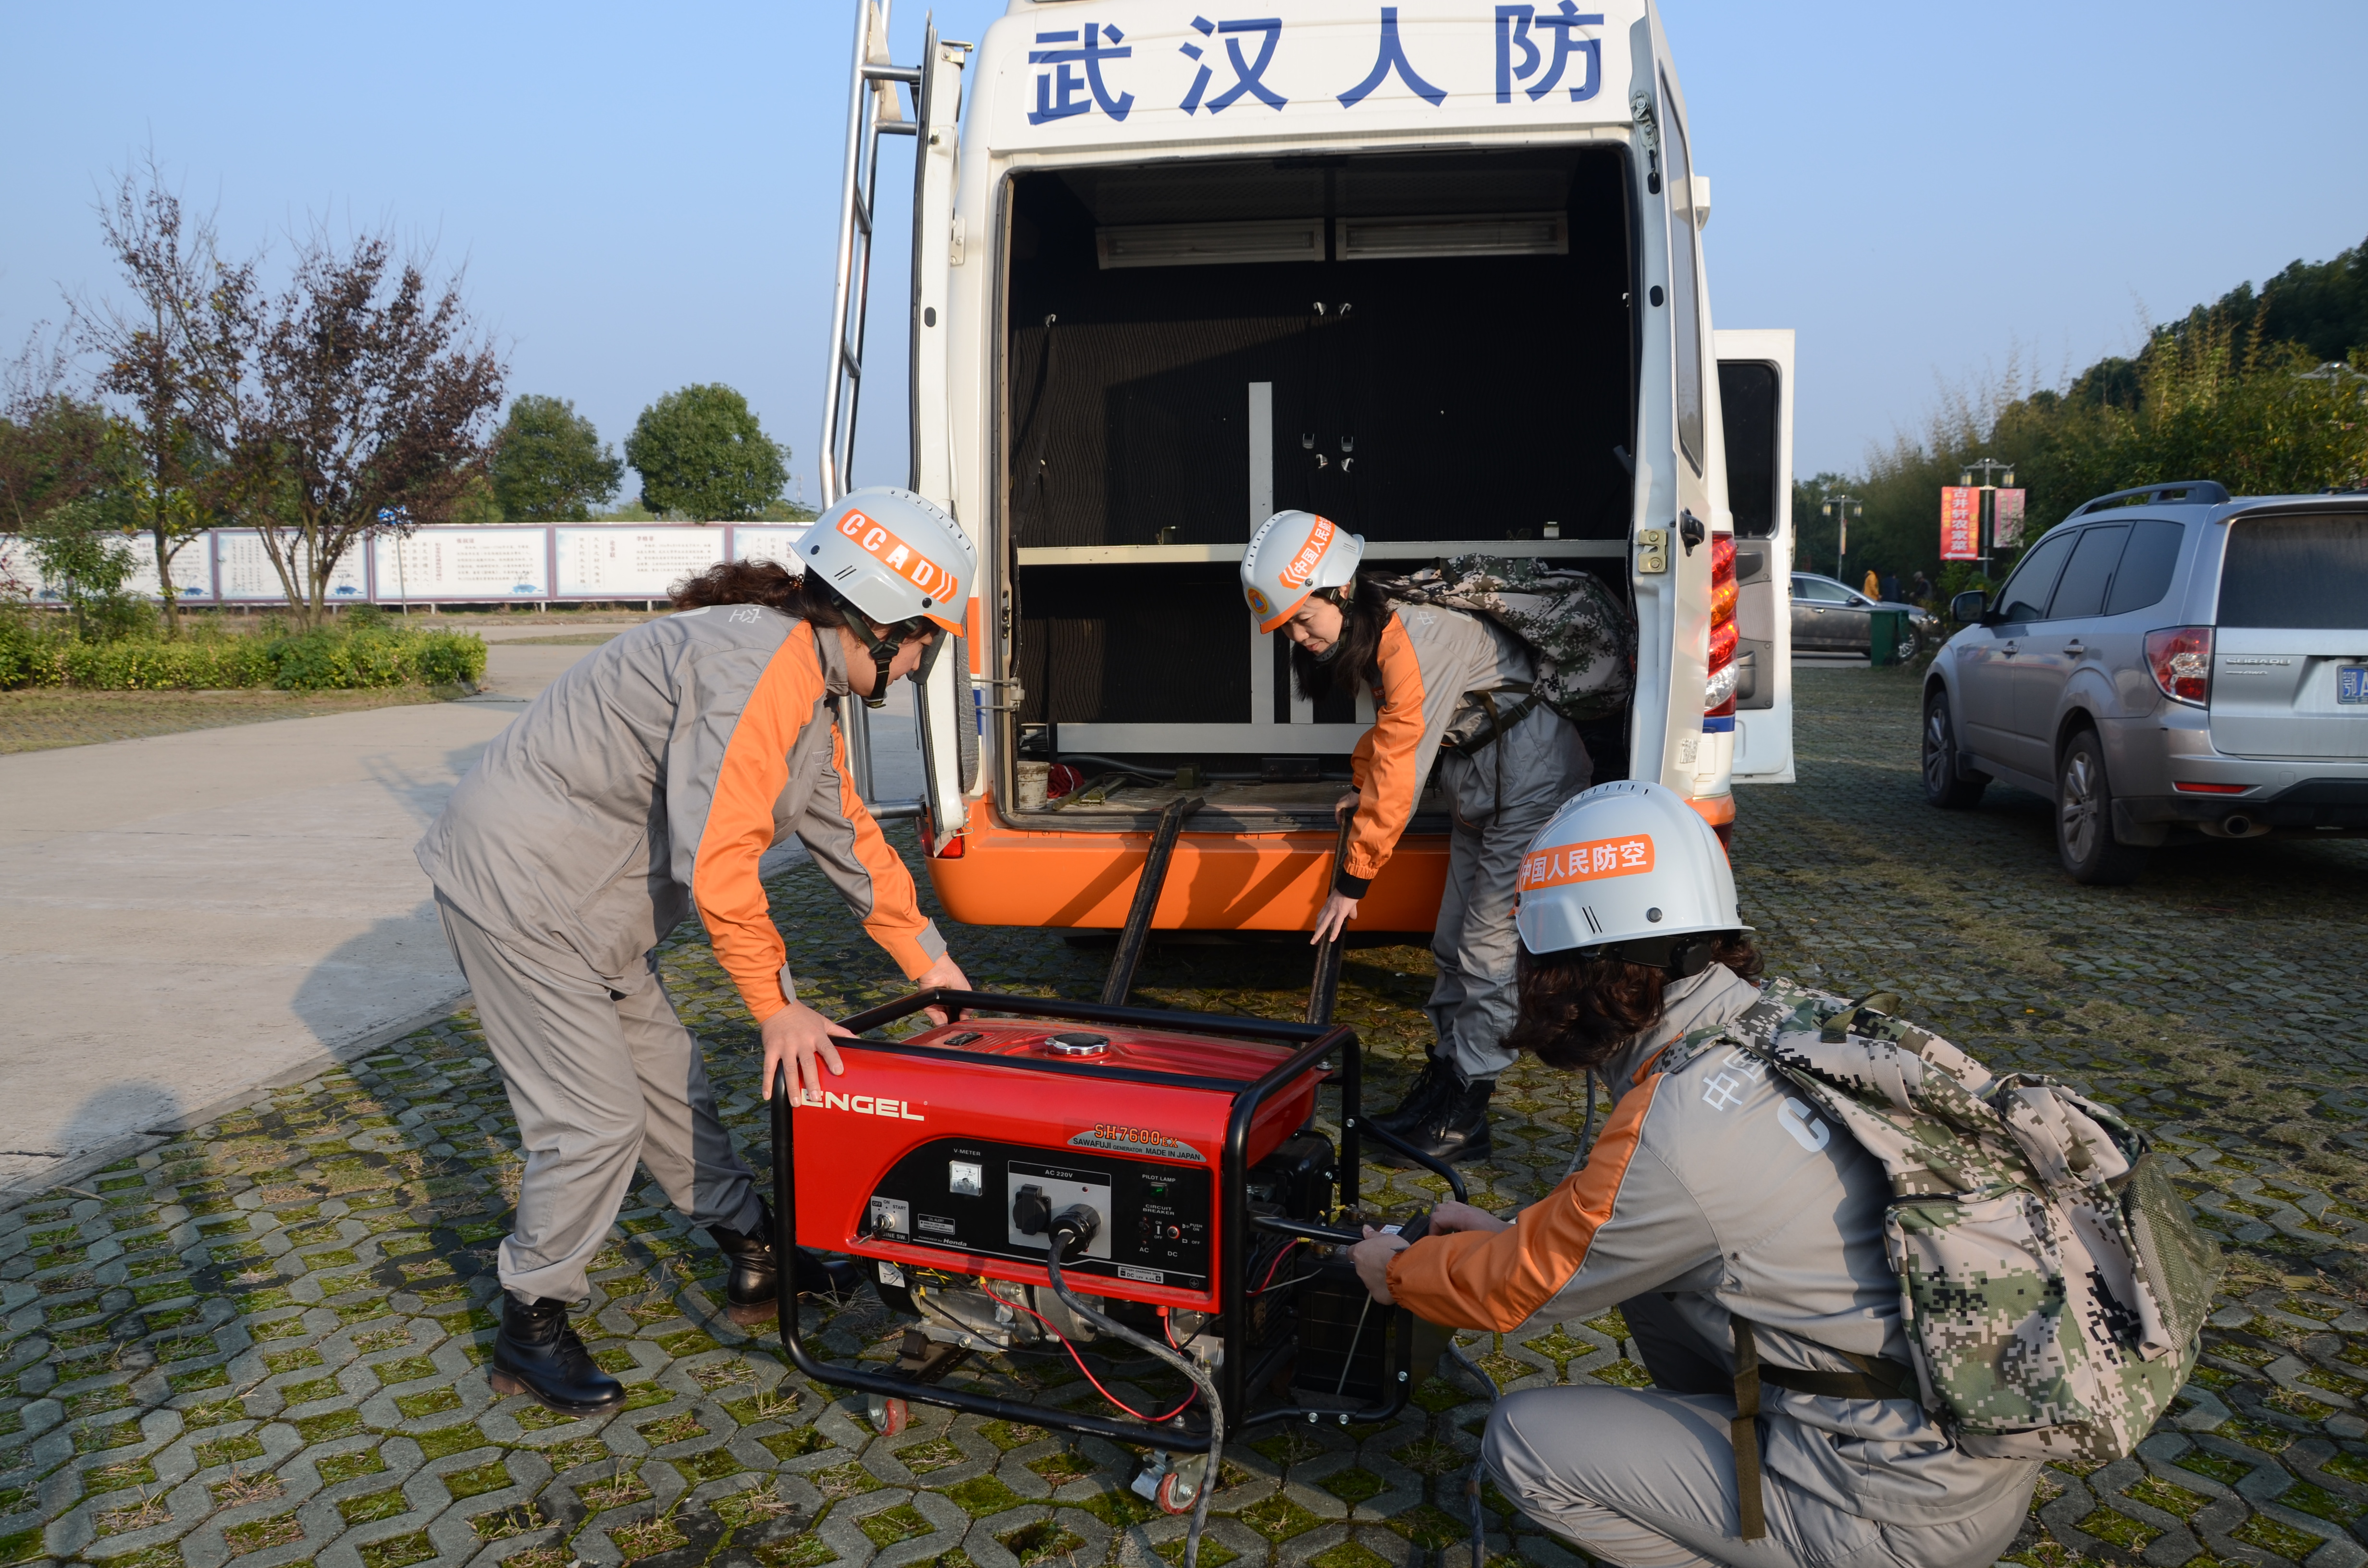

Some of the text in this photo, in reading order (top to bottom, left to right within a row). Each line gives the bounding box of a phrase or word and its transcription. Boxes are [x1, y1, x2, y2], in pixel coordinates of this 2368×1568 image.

[1027, 0, 1603, 125] 武汉人防
[1951, 487, 1969, 551] 古井轩农家菜
[842, 514, 934, 586] CCAD
[1521, 841, 1647, 885] 中国人民防空
[801, 1088, 924, 1121] ENGEL
[1777, 1089, 1844, 1152] C
[1073, 1138, 1111, 1149] SAWAFUJI
[1113, 1145, 1142, 1153] GENERATOR
[1146, 1148, 1166, 1156] MADE
[1177, 1152, 1200, 1161] JAPAN
[1094, 1124, 1178, 1148] SH7600EX
[943, 1238, 967, 1247] Honda
